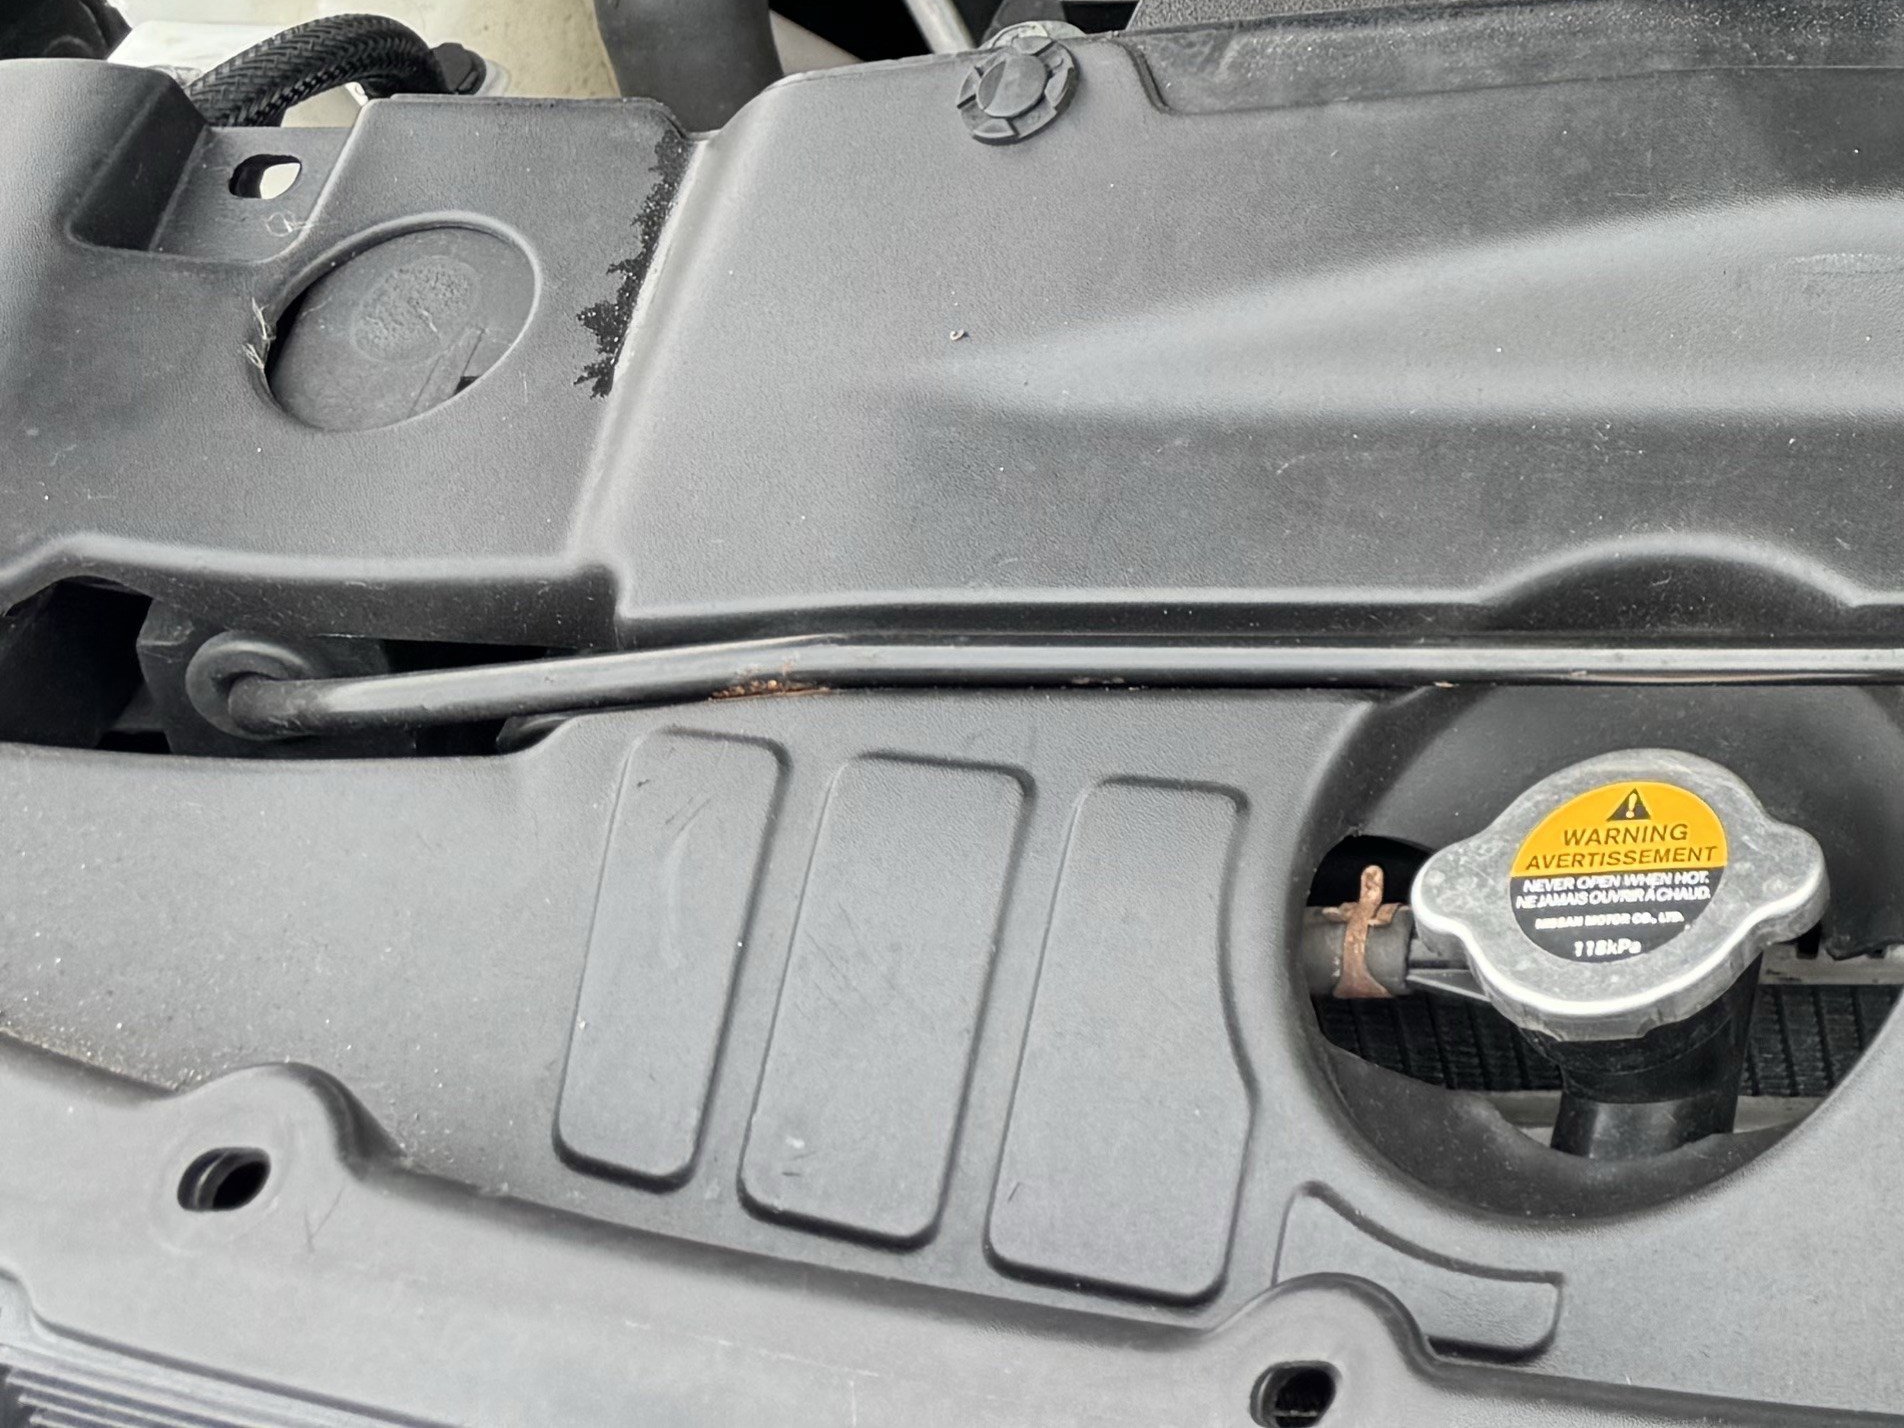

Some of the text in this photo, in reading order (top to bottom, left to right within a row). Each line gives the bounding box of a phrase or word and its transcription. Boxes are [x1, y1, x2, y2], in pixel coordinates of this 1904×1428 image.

[1563, 823, 1688, 846] WARNING
[1525, 846, 1719, 871] AVERTISSEMENT
[1522, 870, 1710, 892] NEVER OPEN WHEN HOT.
[1516, 895, 1538, 909] NE
